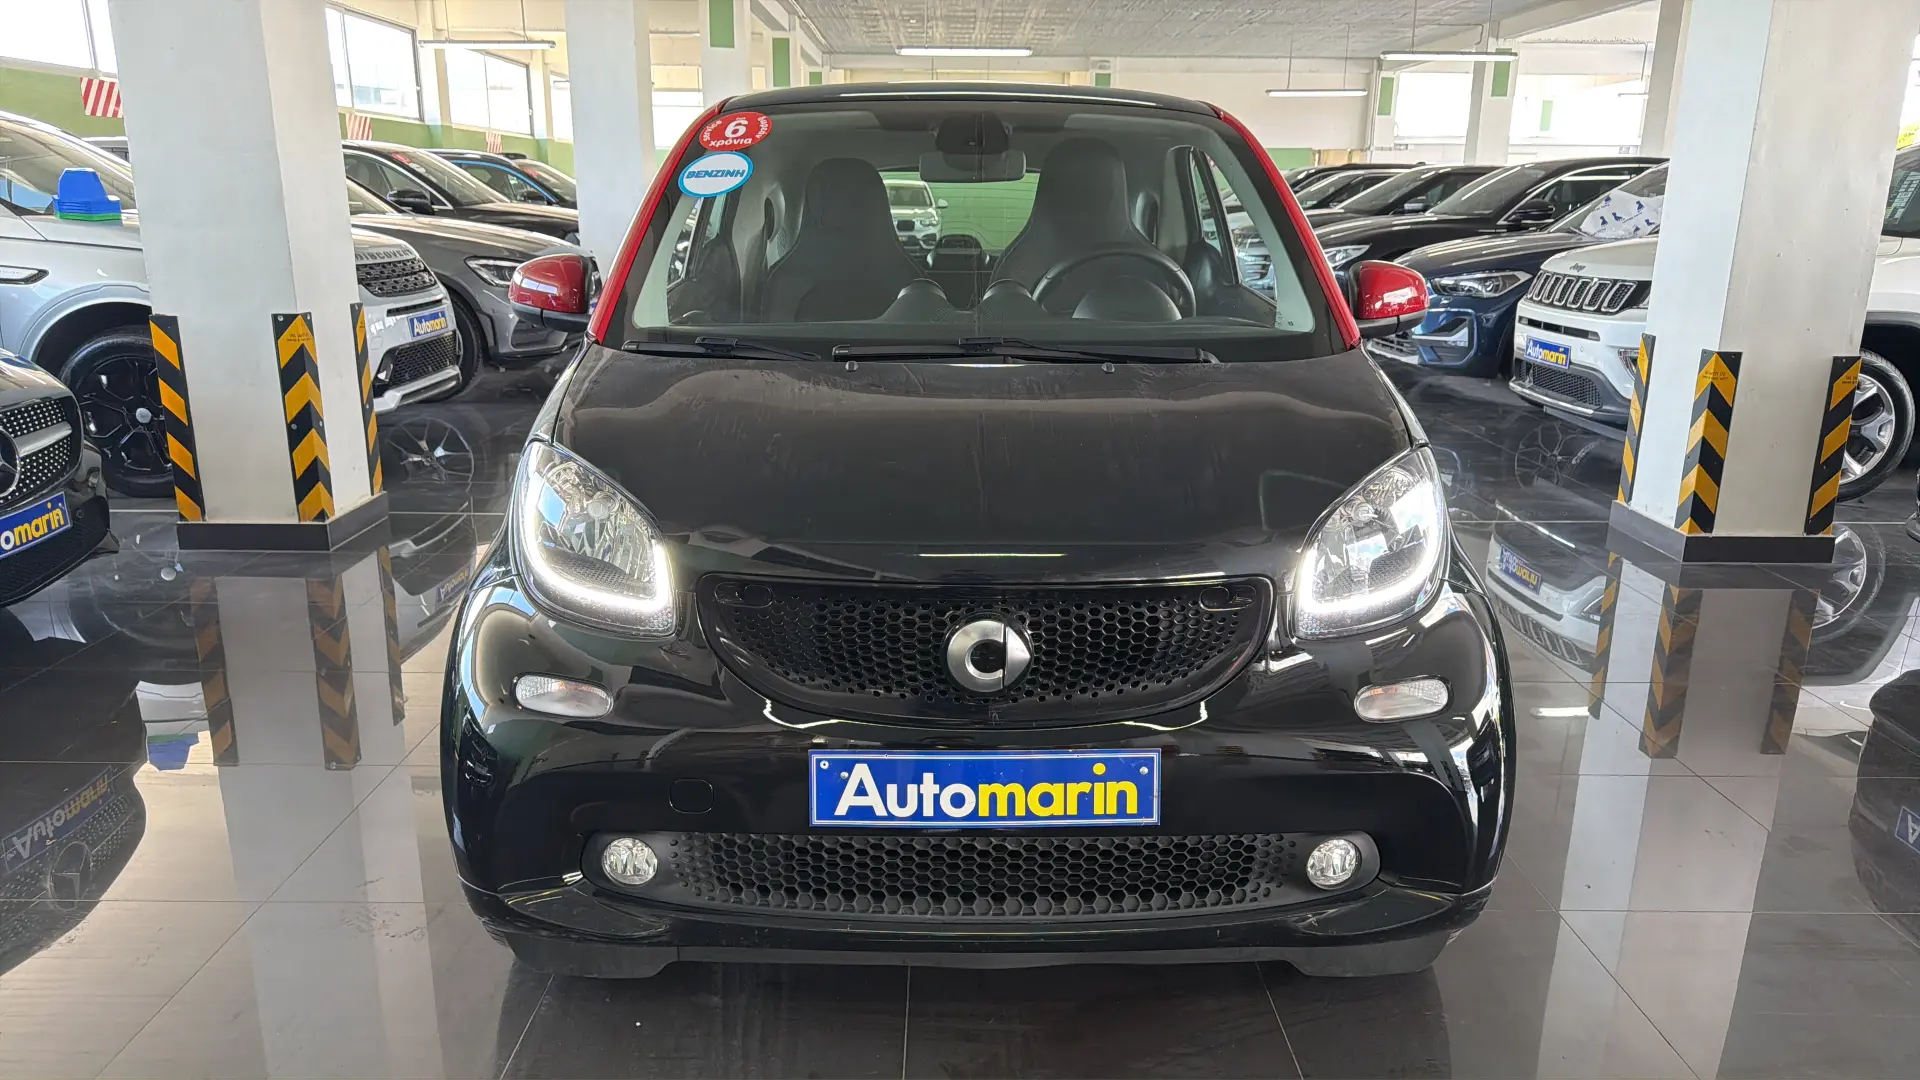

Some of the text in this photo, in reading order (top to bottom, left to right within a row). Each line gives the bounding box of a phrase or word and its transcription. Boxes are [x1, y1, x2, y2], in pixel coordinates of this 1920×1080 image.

[703, 120, 722, 142] service
[724, 119, 749, 138] 6
[709, 137, 753, 148] χρόνια
[414, 312, 447, 336] Automarin
[1527, 341, 1567, 365] Automarin
[834, 762, 1138, 818] Automarin
